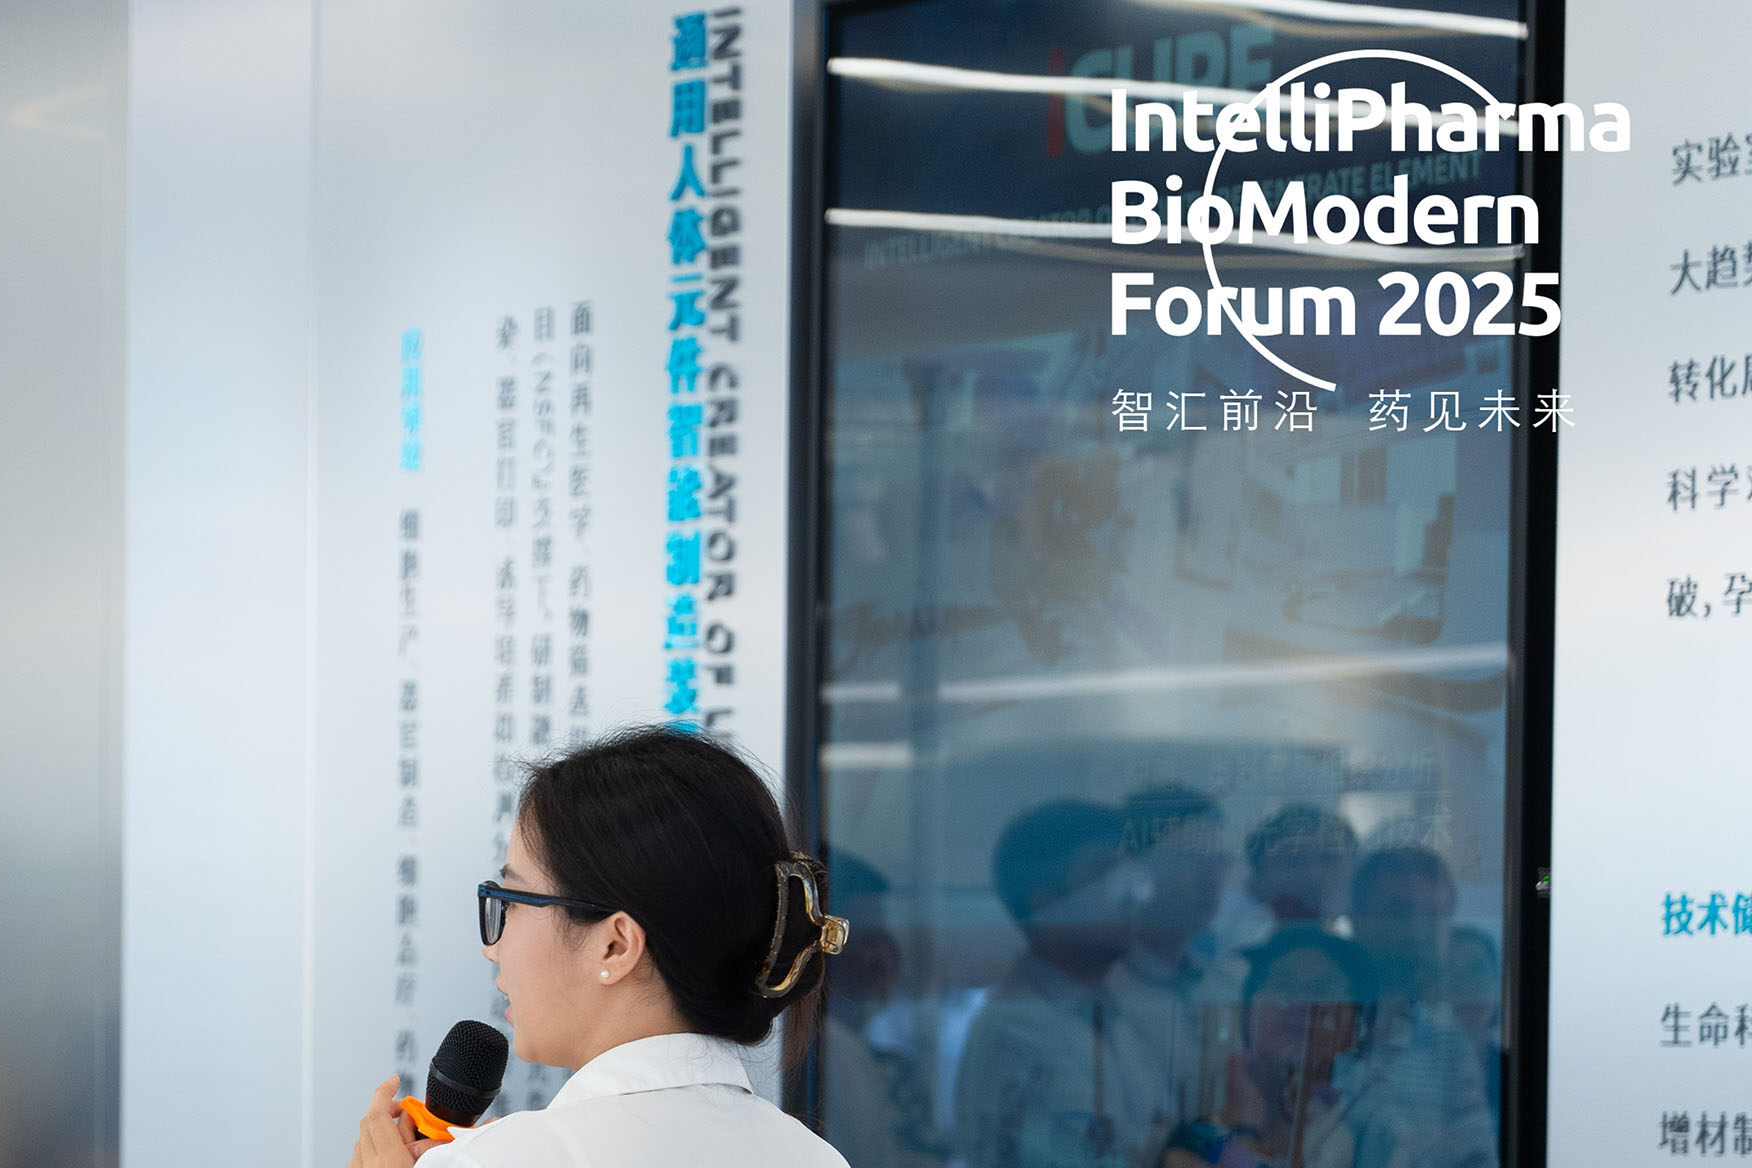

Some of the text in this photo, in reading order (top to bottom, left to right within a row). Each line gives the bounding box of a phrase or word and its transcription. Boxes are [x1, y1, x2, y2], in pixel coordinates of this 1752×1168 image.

[705, 7, 743, 343] INTELLIGENT
[1671, 131, 1752, 186] 实验
[1670, 239, 1752, 297] 大趋
[703, 361, 739, 602] CREATOR
[1666, 463, 1752, 513] 科学
[702, 622, 737, 686] OF
